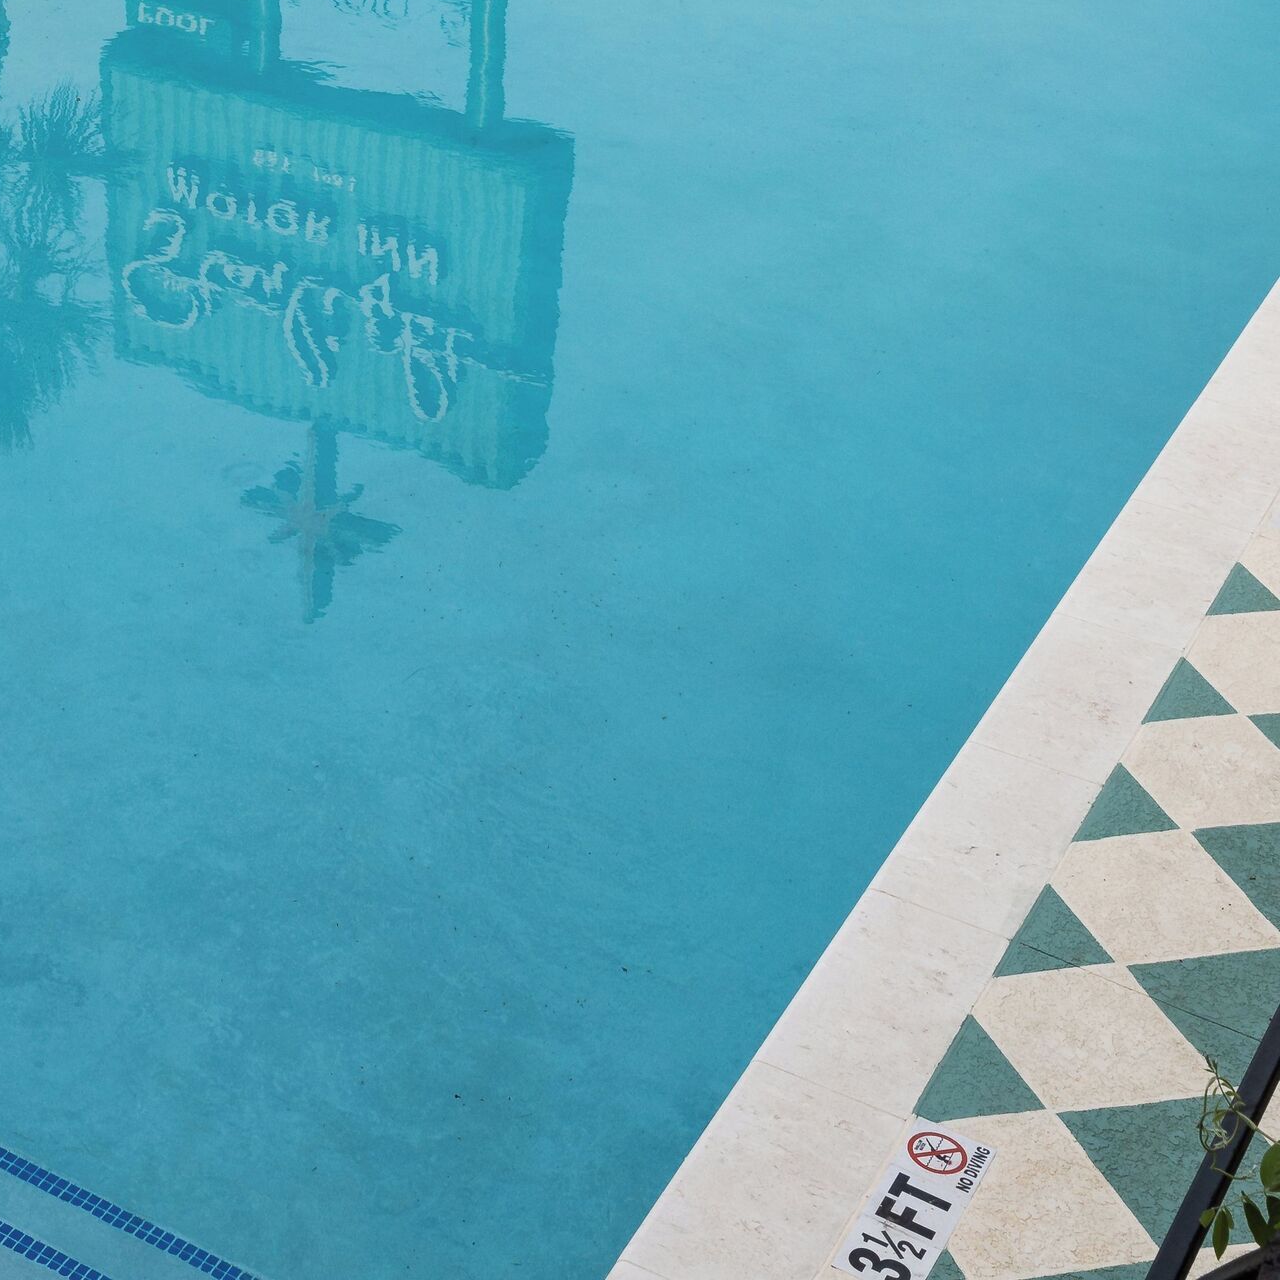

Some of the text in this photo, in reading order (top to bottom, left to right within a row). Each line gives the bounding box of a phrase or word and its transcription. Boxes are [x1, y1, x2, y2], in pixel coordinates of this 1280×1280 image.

[955, 1146, 991, 1193] NO DIVING
[875, 1172, 952, 1241] FT
